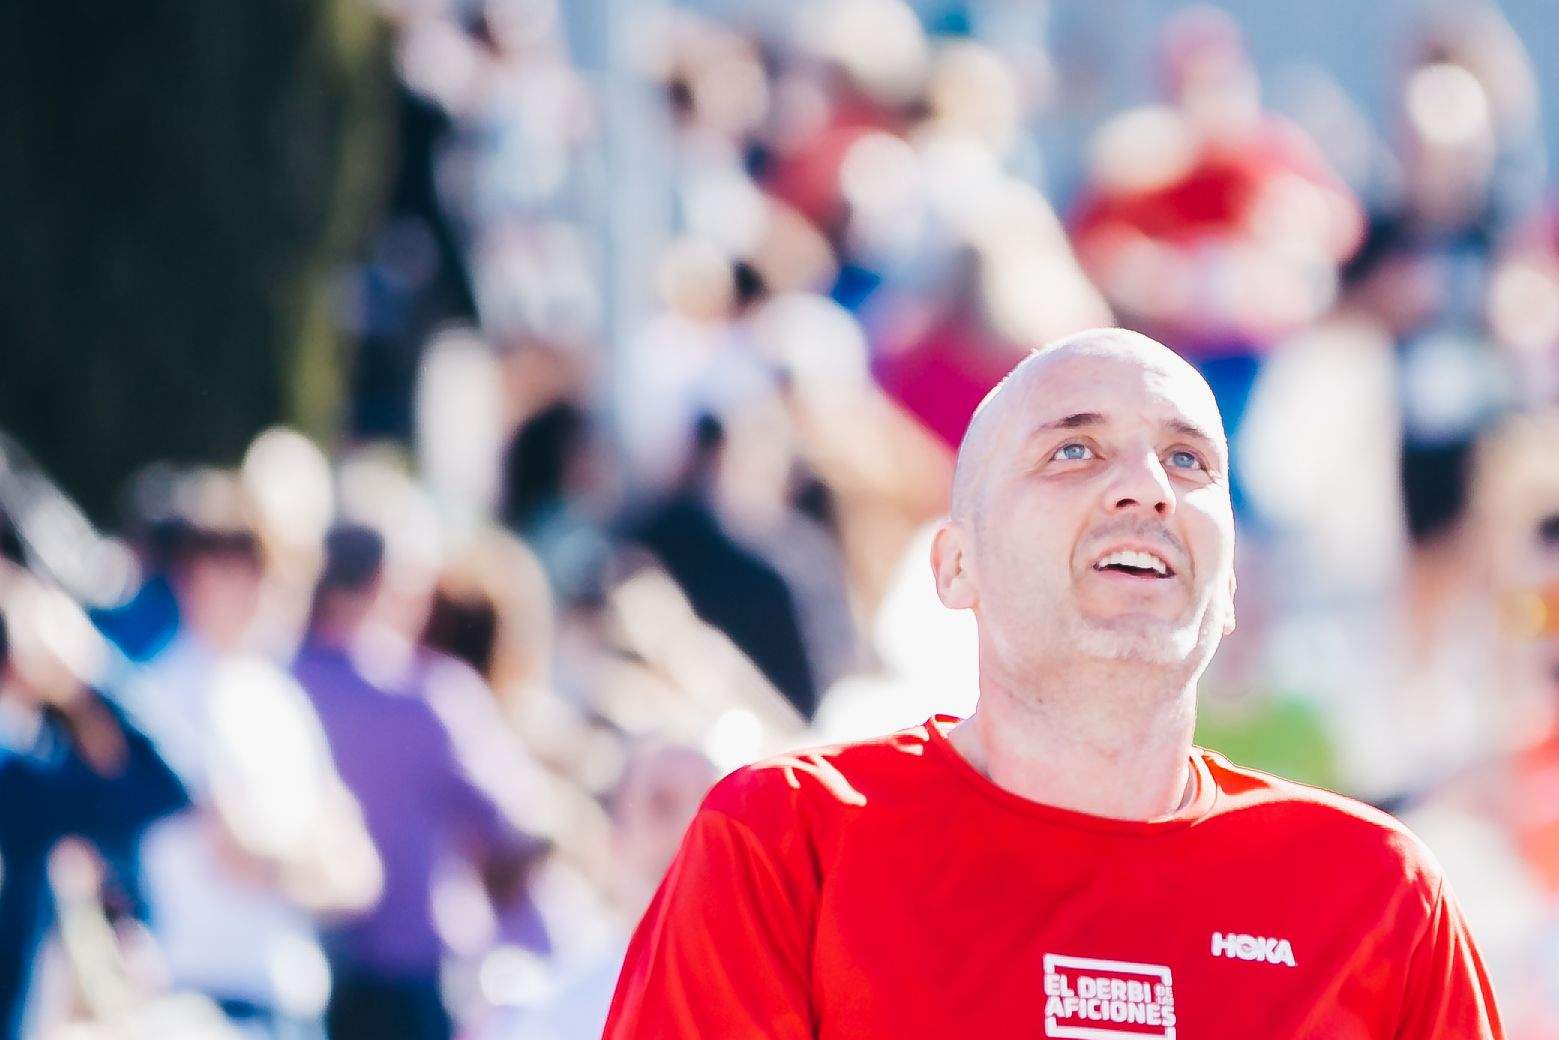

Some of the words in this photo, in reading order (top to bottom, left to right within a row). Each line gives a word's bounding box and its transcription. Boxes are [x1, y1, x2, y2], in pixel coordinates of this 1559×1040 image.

[1211, 932, 1297, 967] HOKA
[1044, 973, 1075, 997] EL
[1077, 975, 1152, 1003] DERBI
[1044, 995, 1176, 1027] AFICIONES
